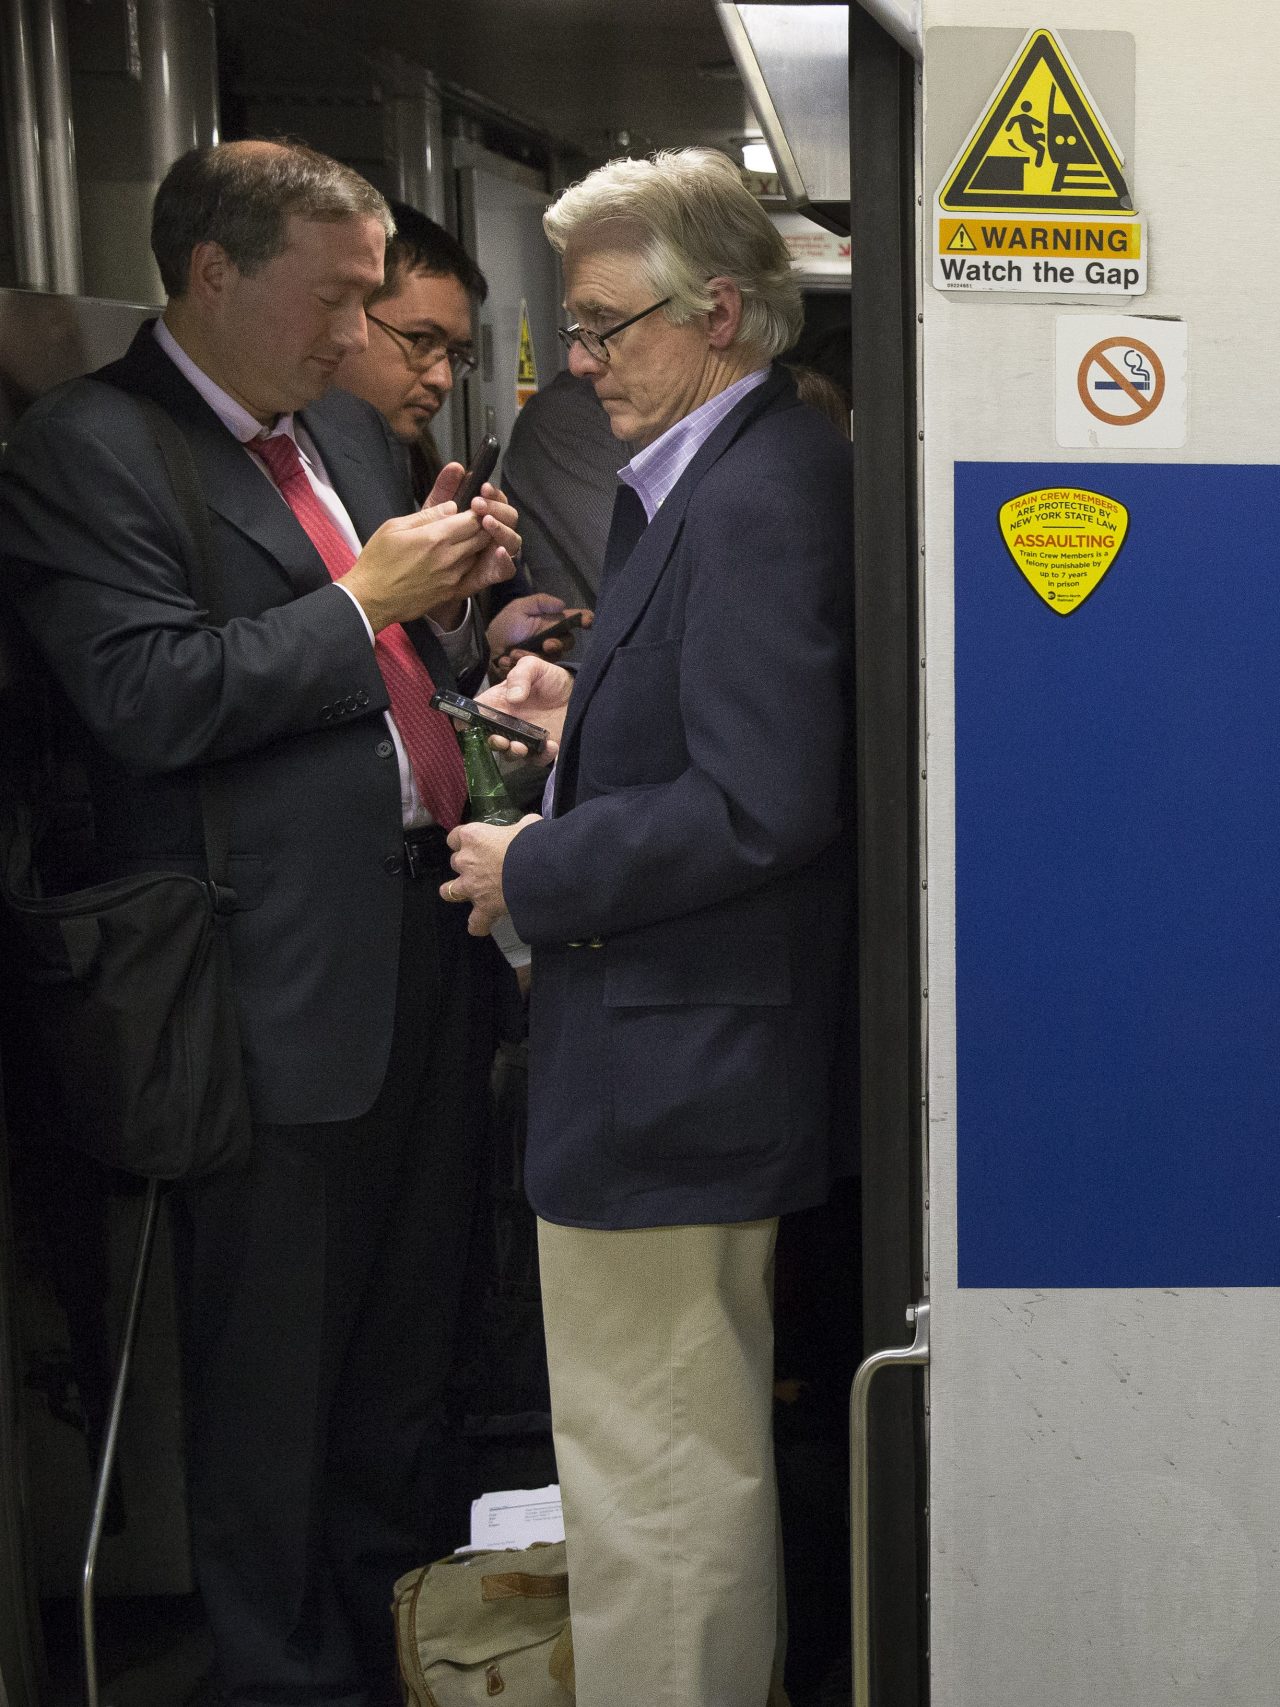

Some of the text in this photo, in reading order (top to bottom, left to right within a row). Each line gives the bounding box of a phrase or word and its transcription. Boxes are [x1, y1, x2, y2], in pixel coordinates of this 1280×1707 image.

[981, 226, 1128, 252] WARNING
[940, 258, 1140, 289] Watch the Gap
[1010, 492, 1119, 514] TRAIN CREW MEMBERS
[1016, 501, 1111, 519] ARE PROTECTED BY
[1010, 511, 1117, 532] NEW YORK STATE LAW
[1013, 534, 1115, 548] ASSAULTING
[1020, 549, 1037, 558] Train
[1026, 559, 1102, 569] felony punishable by
[1068, 571, 1088, 579] years
[1057, 581, 1080, 589] prison
